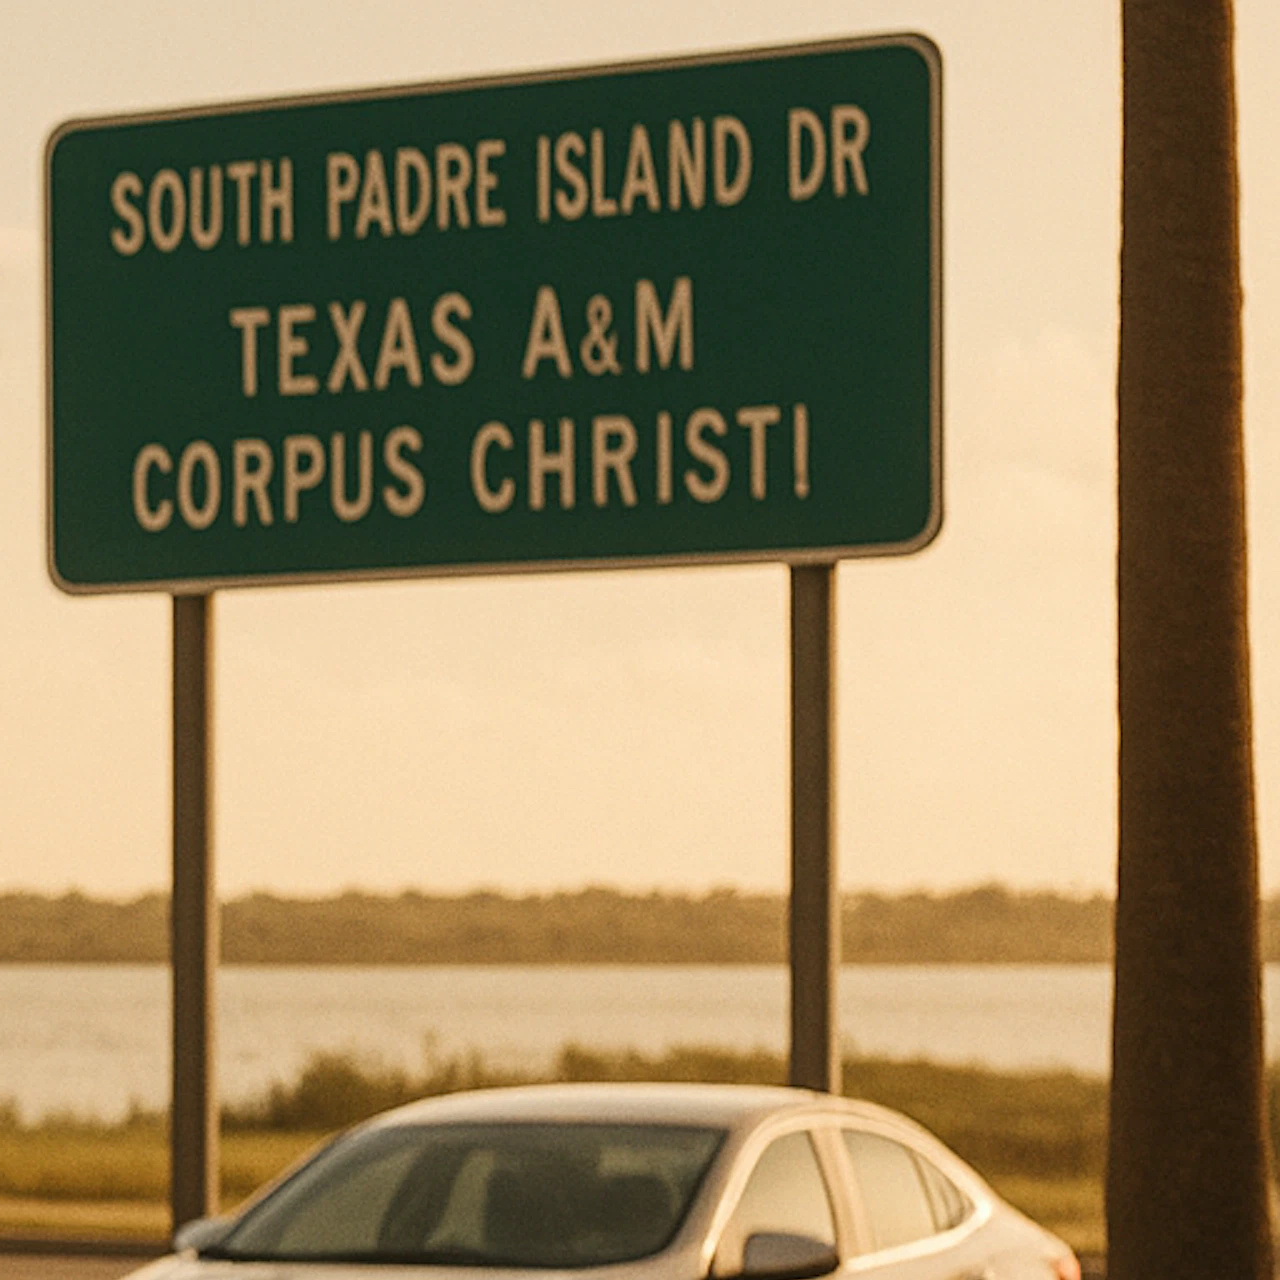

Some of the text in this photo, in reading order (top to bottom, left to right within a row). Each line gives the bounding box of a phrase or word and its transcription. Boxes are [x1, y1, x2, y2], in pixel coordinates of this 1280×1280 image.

[111, 104, 870, 256] SOUTH PADRE ISLAND DR
[230, 276, 694, 397] TEXAS A&M
[132, 426, 425, 532] CORPUS
